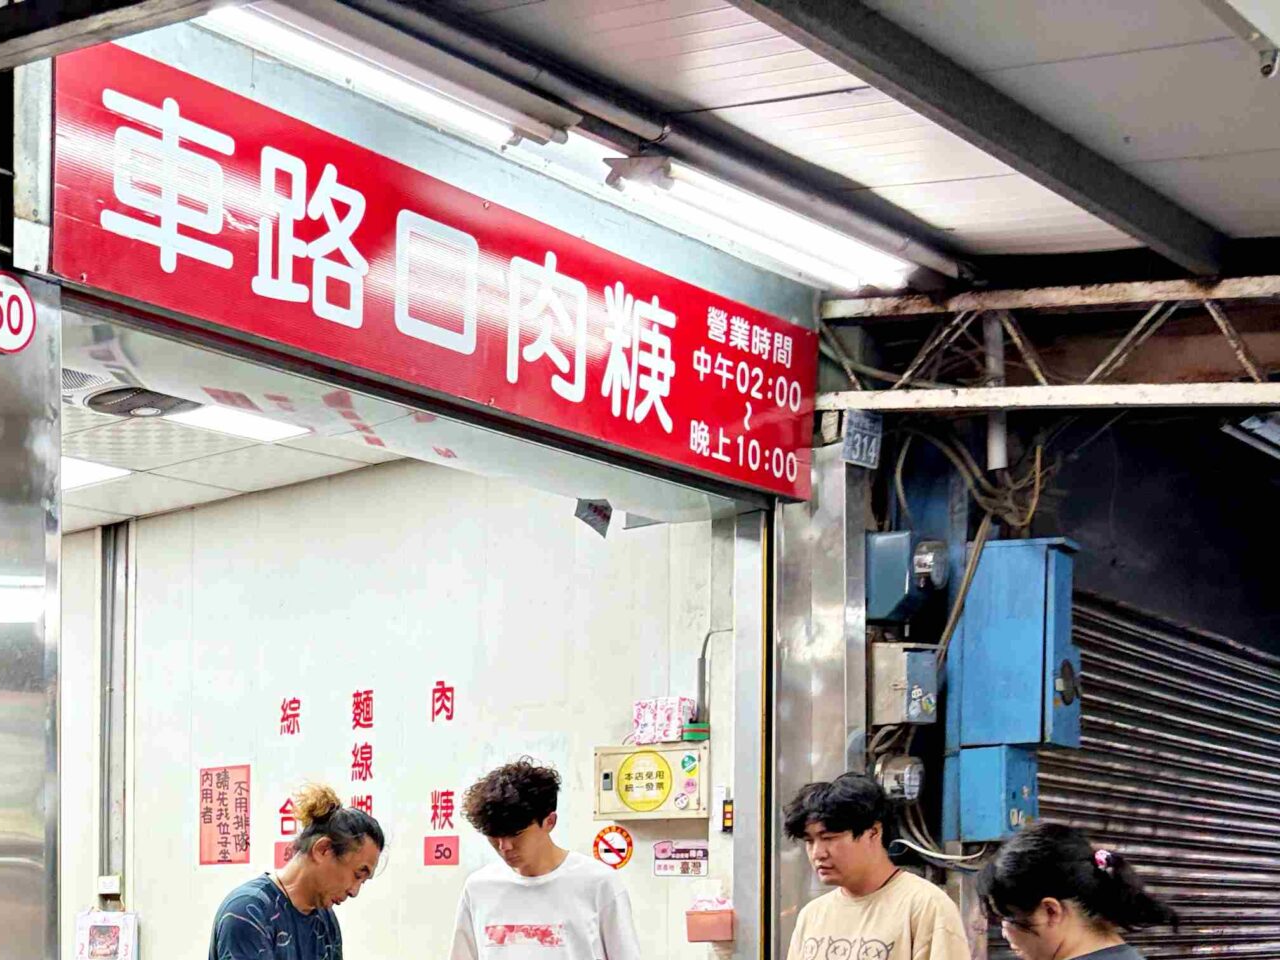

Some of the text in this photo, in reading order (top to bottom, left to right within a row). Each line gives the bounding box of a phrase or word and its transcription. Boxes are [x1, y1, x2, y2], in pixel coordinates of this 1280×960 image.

[706, 305, 794, 369] 營業時間
[692, 346, 802, 412] 中午02:00
[689, 419, 799, 483] 晚上10:00
[851, 432, 878, 464] 314
[215, 768, 232, 863] 請先找位子坐
[232, 780, 250, 853] 不用排隊
[434, 844, 452, 860] 50
